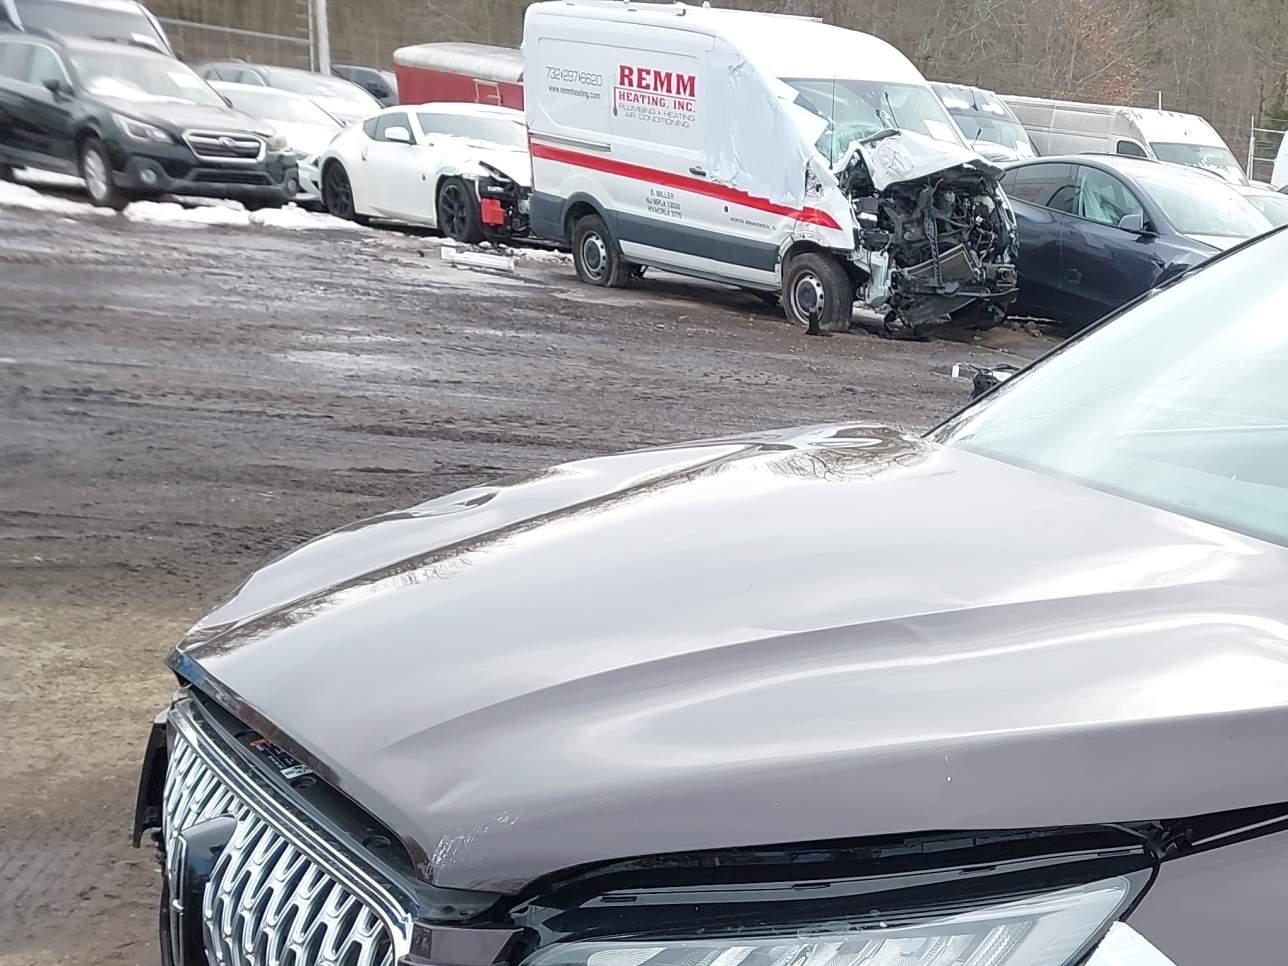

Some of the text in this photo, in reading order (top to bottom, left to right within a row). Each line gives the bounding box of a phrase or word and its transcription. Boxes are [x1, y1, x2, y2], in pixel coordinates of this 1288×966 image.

[619, 65, 696, 97] REMM
[618, 103, 655, 115] PLUMBING
[663, 111, 695, 122] HEATING
[673, 99, 696, 113] INC.
[638, 113, 690, 129] CONDITIONING
